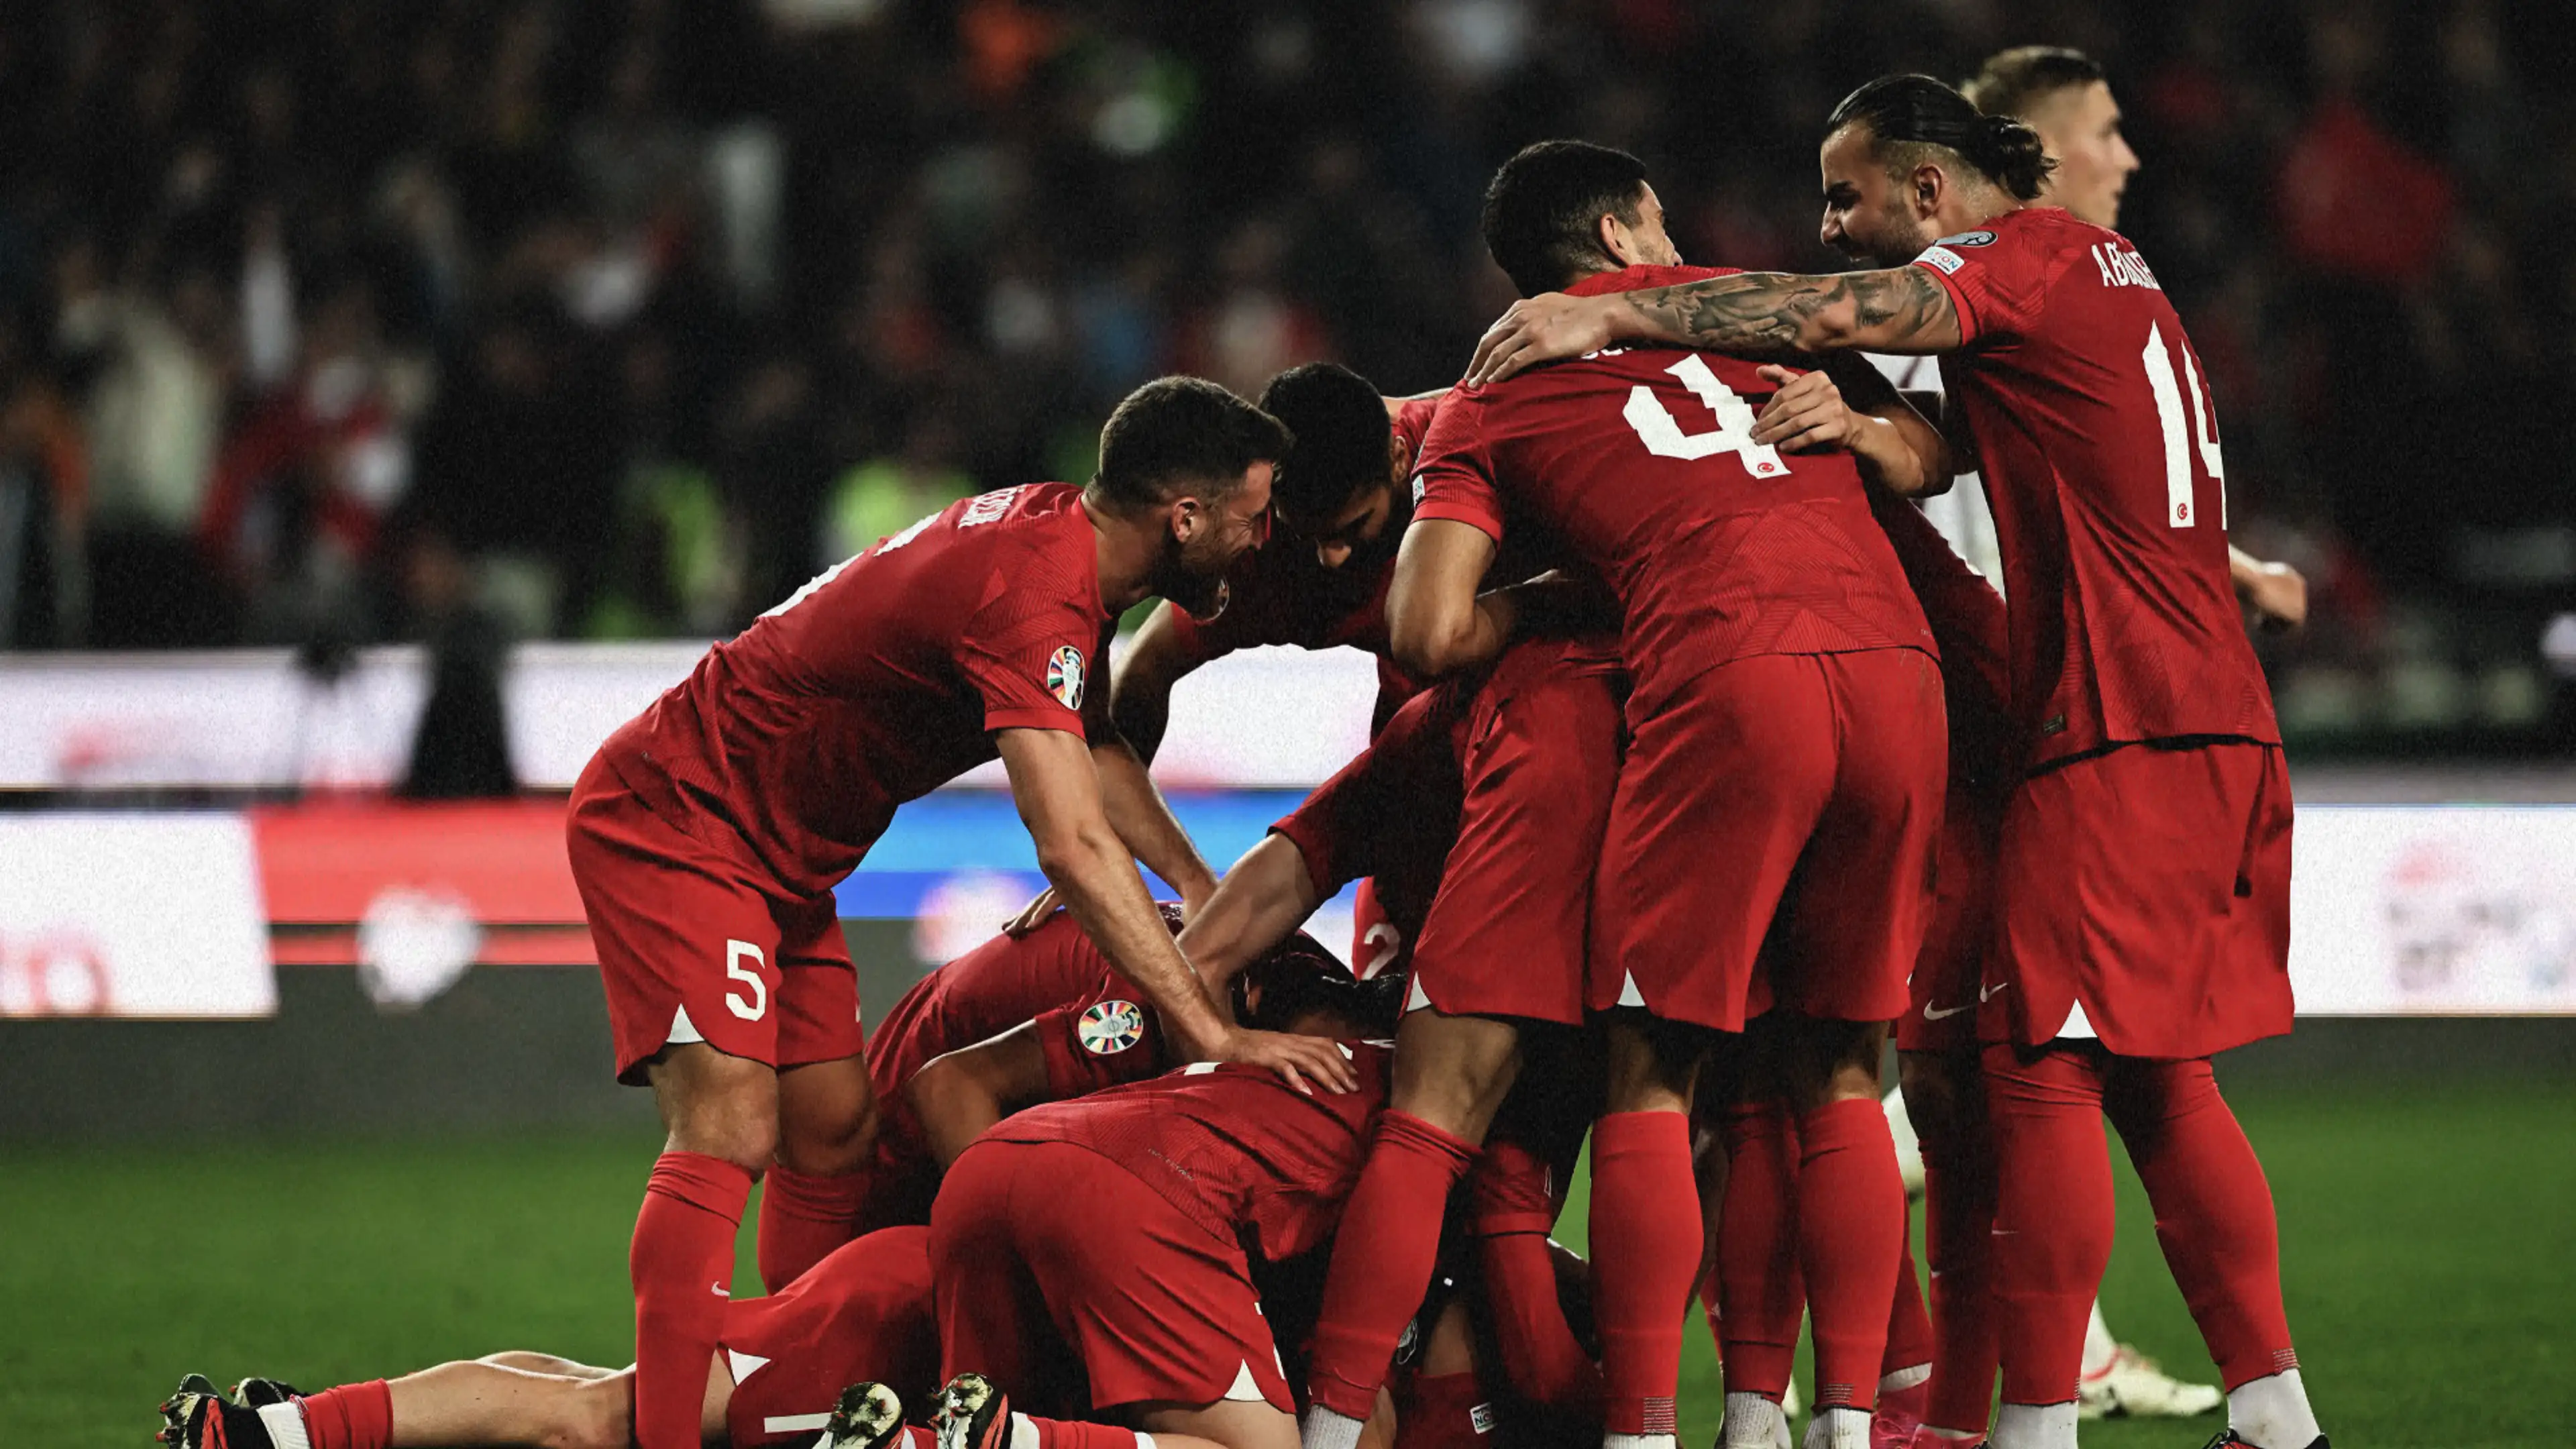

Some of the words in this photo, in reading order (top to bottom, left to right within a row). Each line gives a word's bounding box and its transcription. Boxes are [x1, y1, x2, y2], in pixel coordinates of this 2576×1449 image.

[1622, 353, 1792, 480] 4
[2143, 319, 2228, 531] 14
[726, 938, 766, 1022] 5
